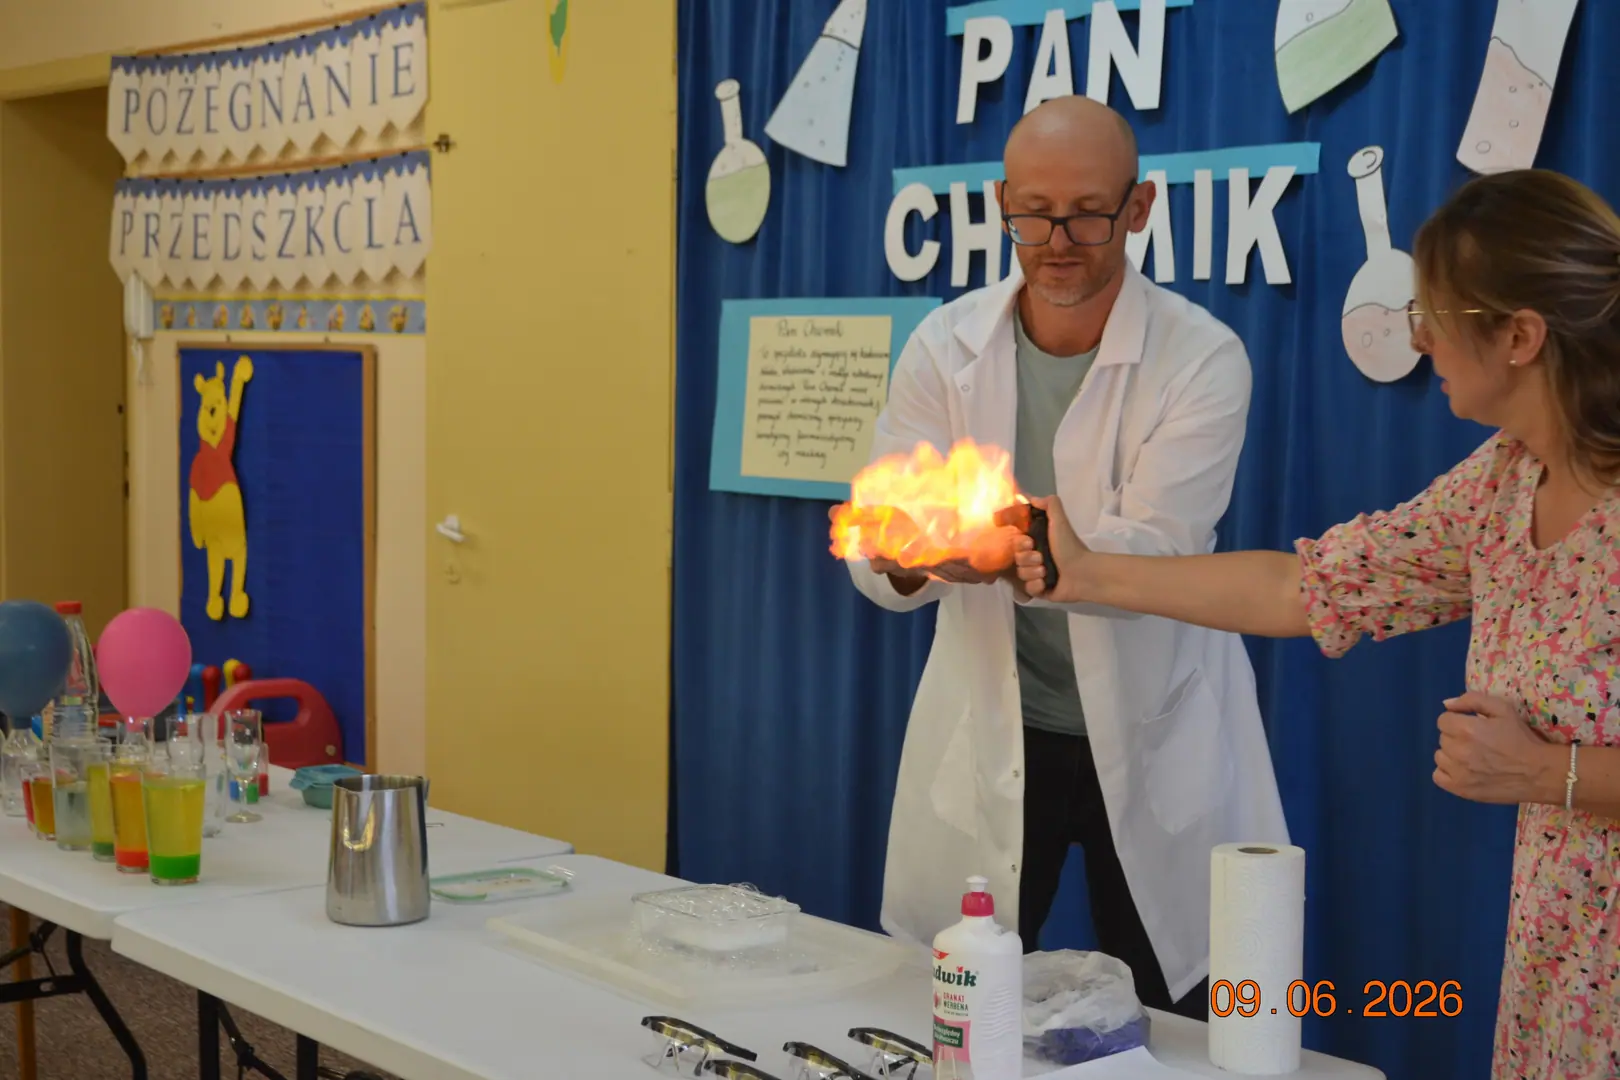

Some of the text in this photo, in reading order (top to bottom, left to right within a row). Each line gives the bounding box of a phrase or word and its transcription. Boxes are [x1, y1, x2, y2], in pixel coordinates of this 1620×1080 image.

[121, 42, 416, 136] POŻEGNANIE
[956, 0, 1166, 124] PAN
[884, 166, 1297, 288] CHMIK
